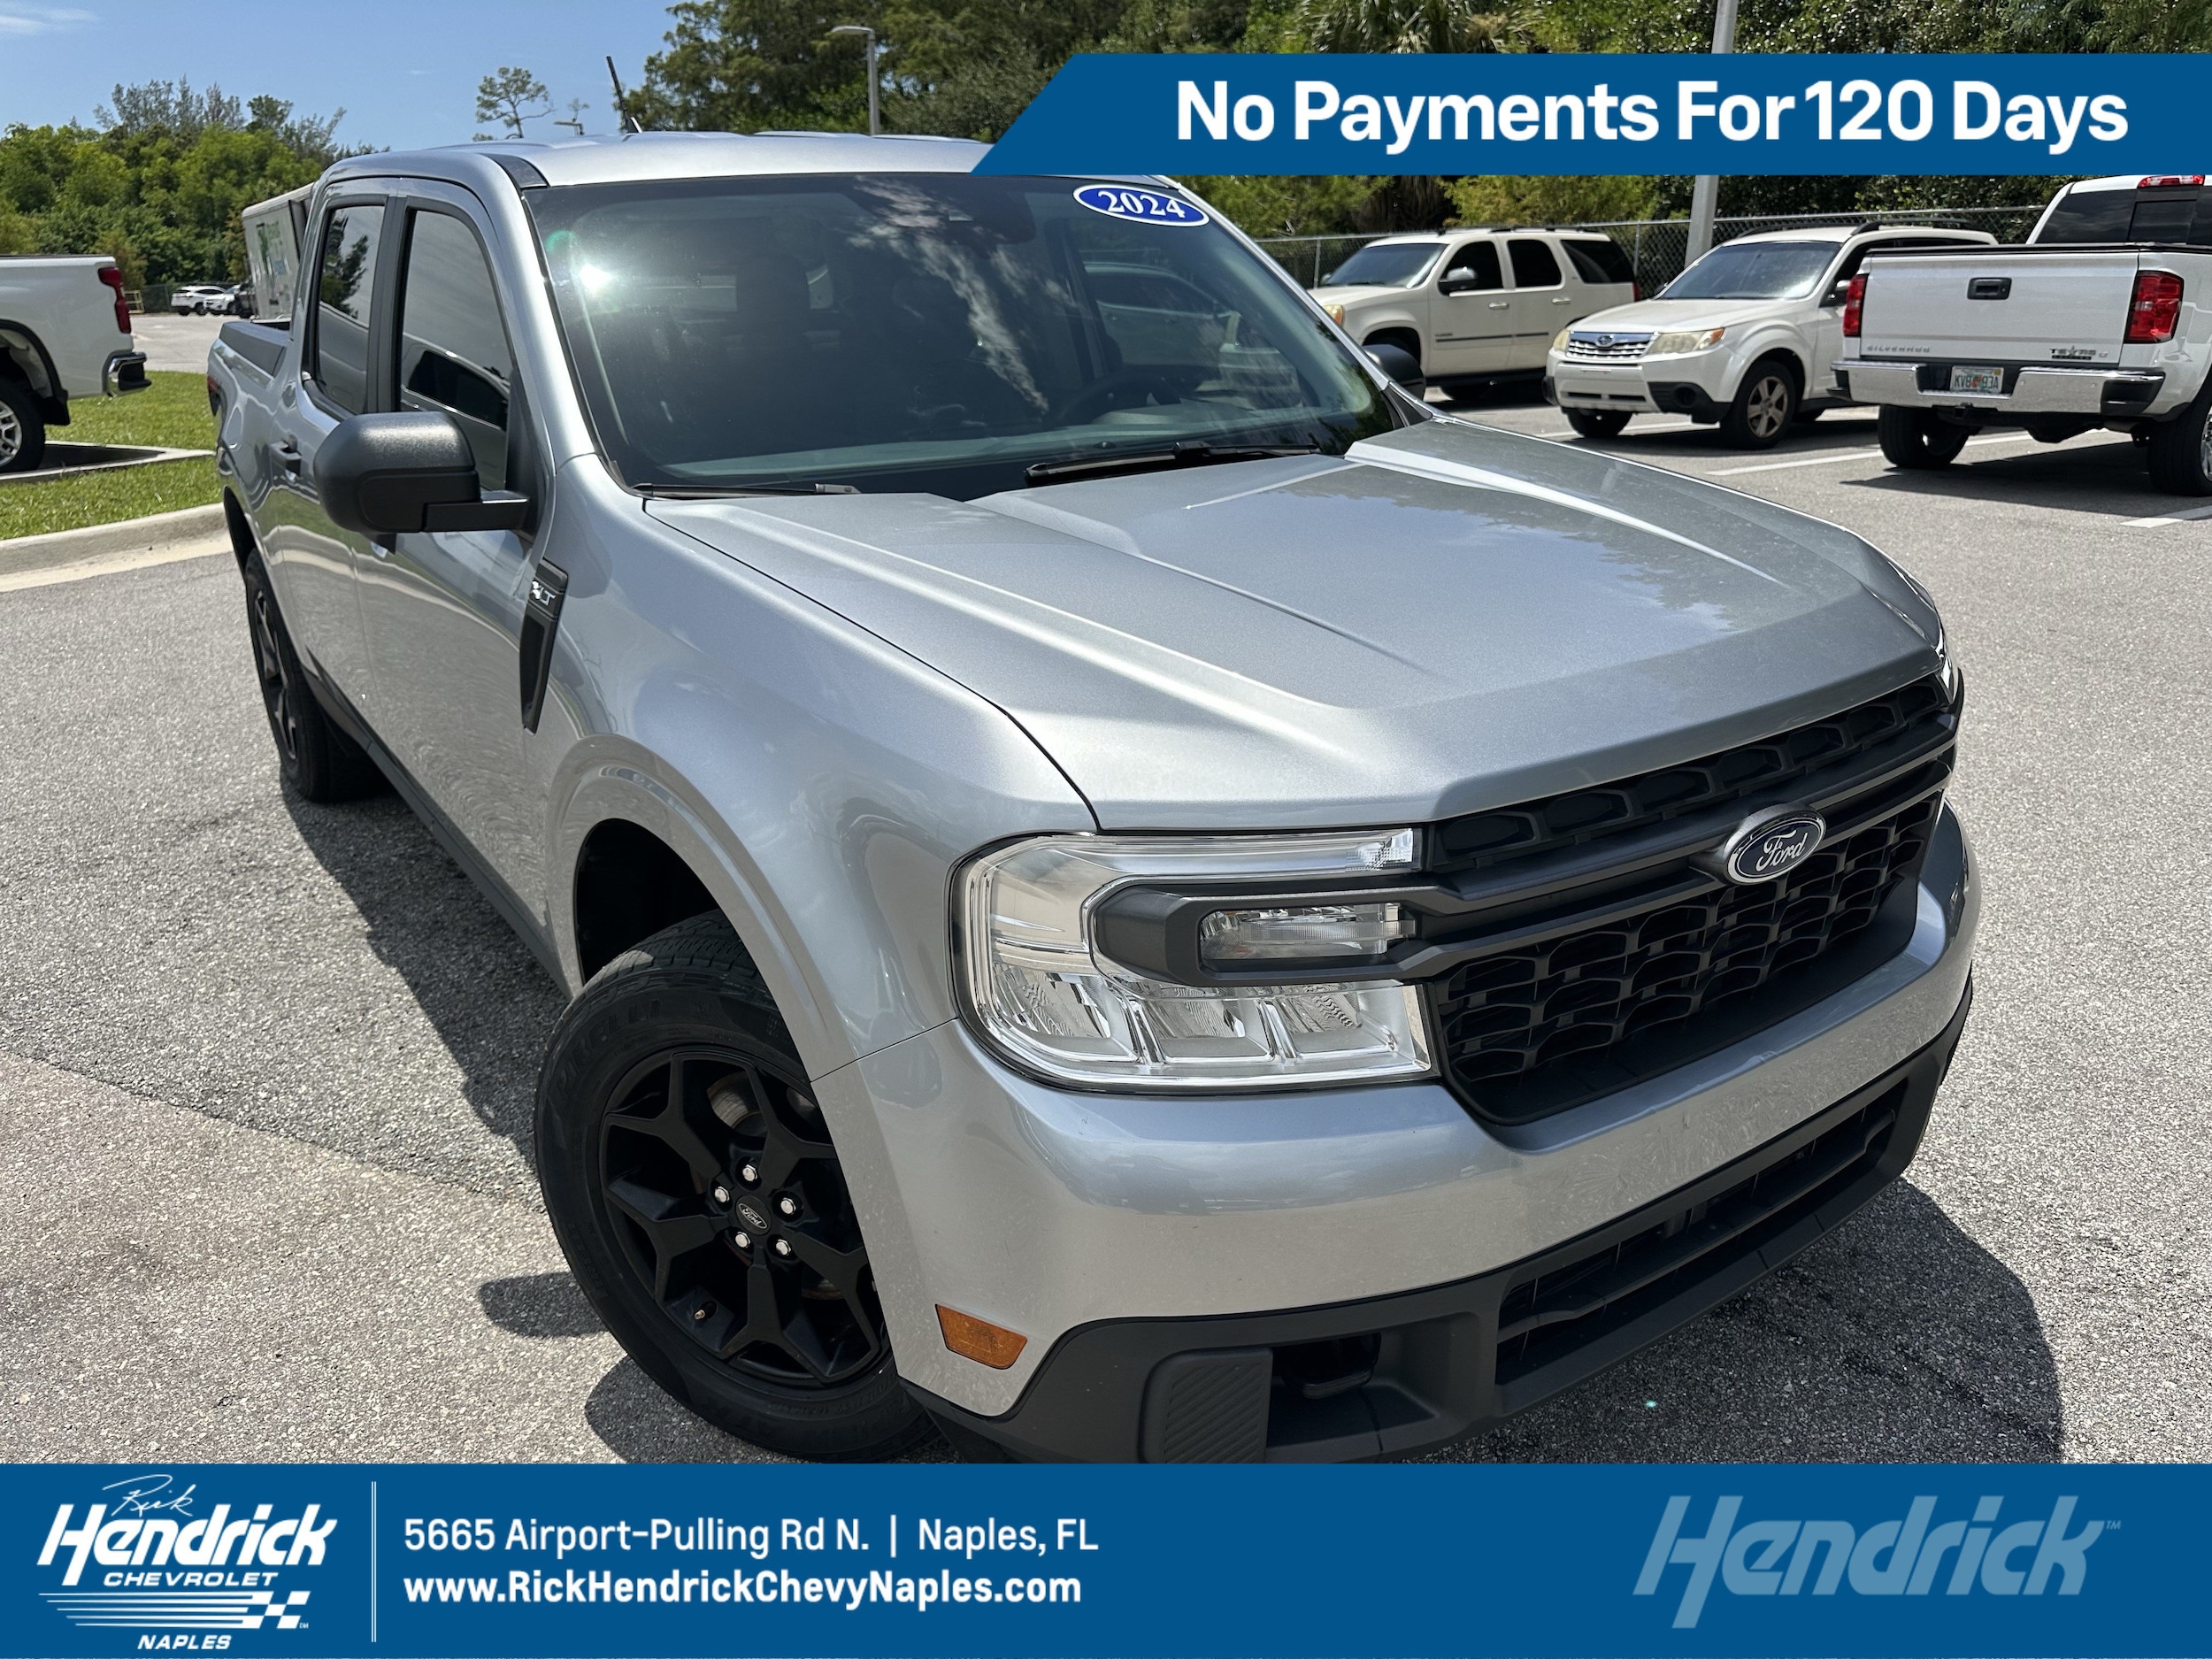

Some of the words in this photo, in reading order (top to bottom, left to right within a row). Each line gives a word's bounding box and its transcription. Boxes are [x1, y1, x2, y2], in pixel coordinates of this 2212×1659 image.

[1097, 181, 1186, 219] 2024
[532, 580, 556, 606] XLT
[1755, 829, 1809, 872] Ford
[742, 1208, 763, 1225] Ford
